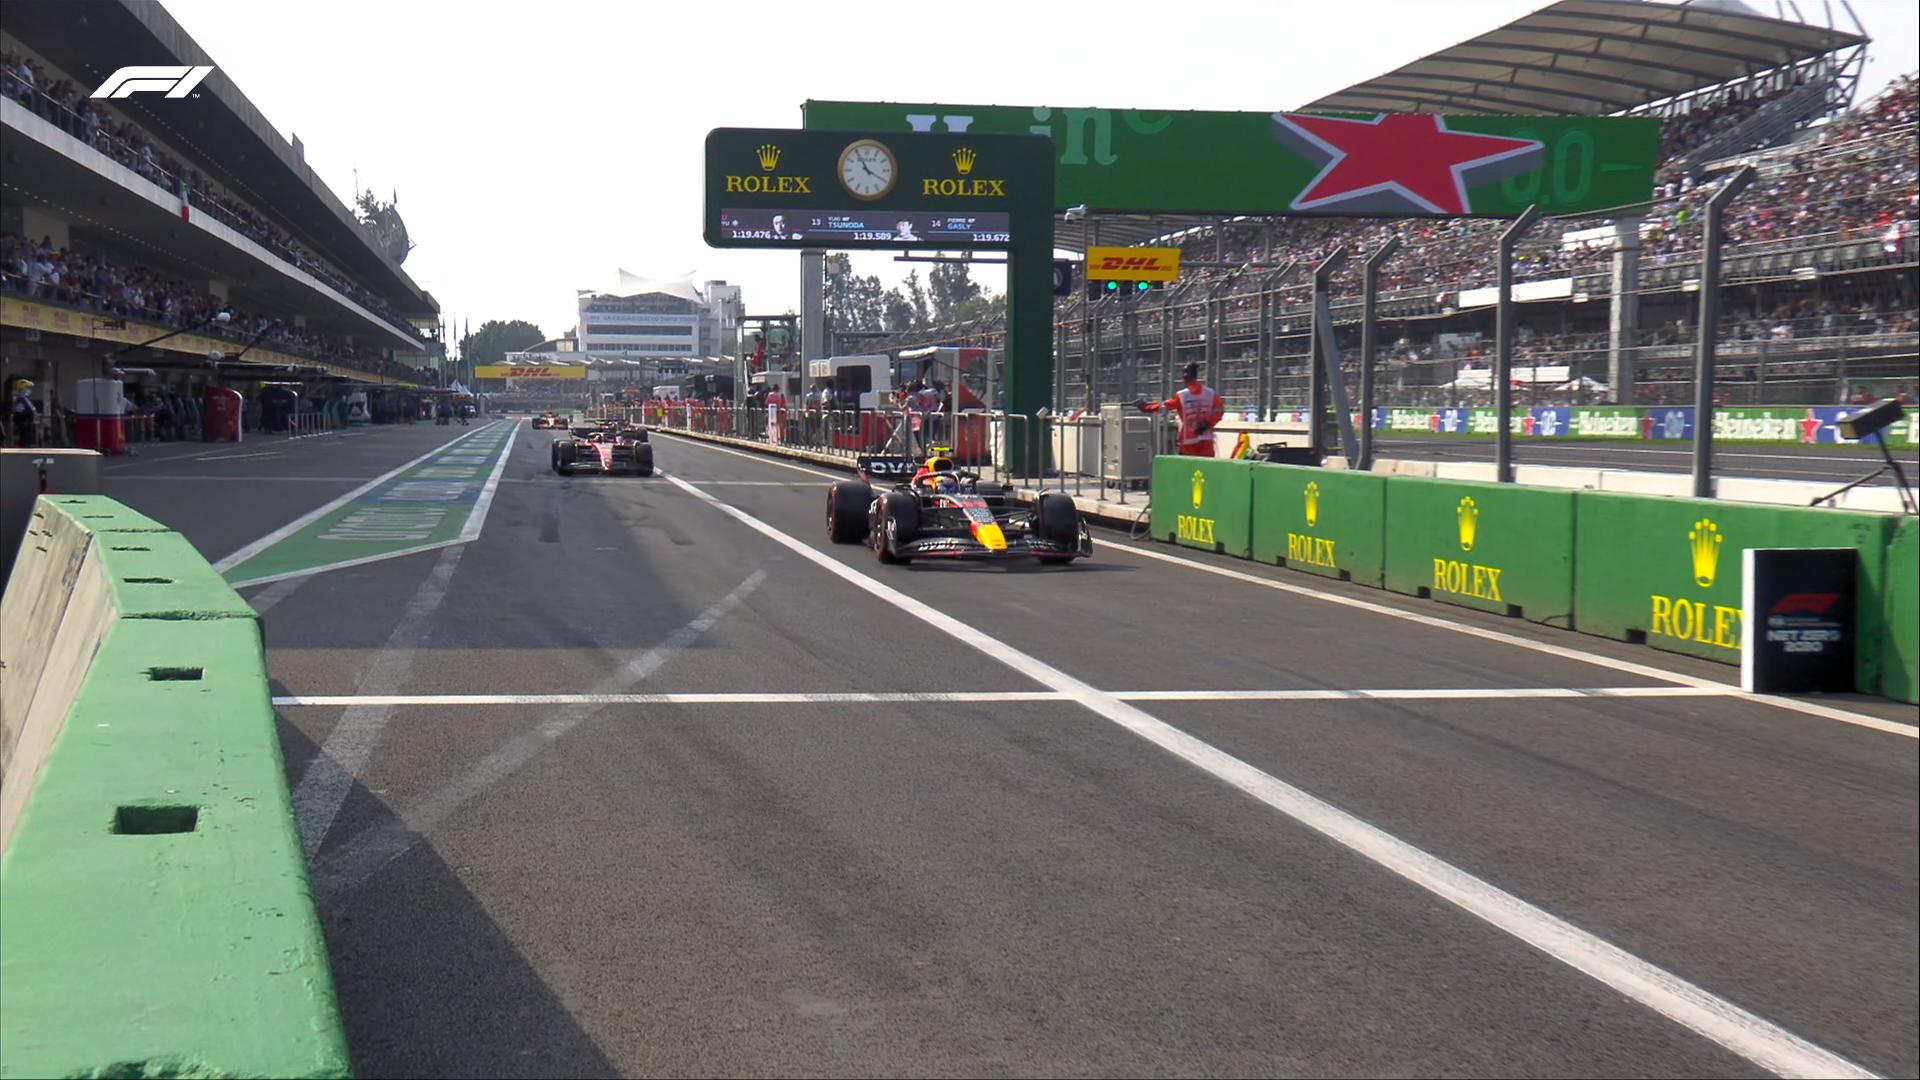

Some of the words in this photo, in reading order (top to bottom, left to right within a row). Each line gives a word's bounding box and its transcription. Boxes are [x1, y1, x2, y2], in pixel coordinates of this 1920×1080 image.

[726, 176, 812, 194] ROLEX
[922, 179, 1006, 197] ROLEX
[732, 230, 771, 239] 1:19.476
[854, 232, 891, 240] 1:19.589
[972, 233, 1010, 241] 1:19.672
[1101, 257, 1161, 271] DHL
[510, 367, 552, 377] DHL
[1177, 514, 1216, 544] ROLEX
[1287, 533, 1337, 568] ROLEX
[1433, 558, 1503, 602] ROLEX
